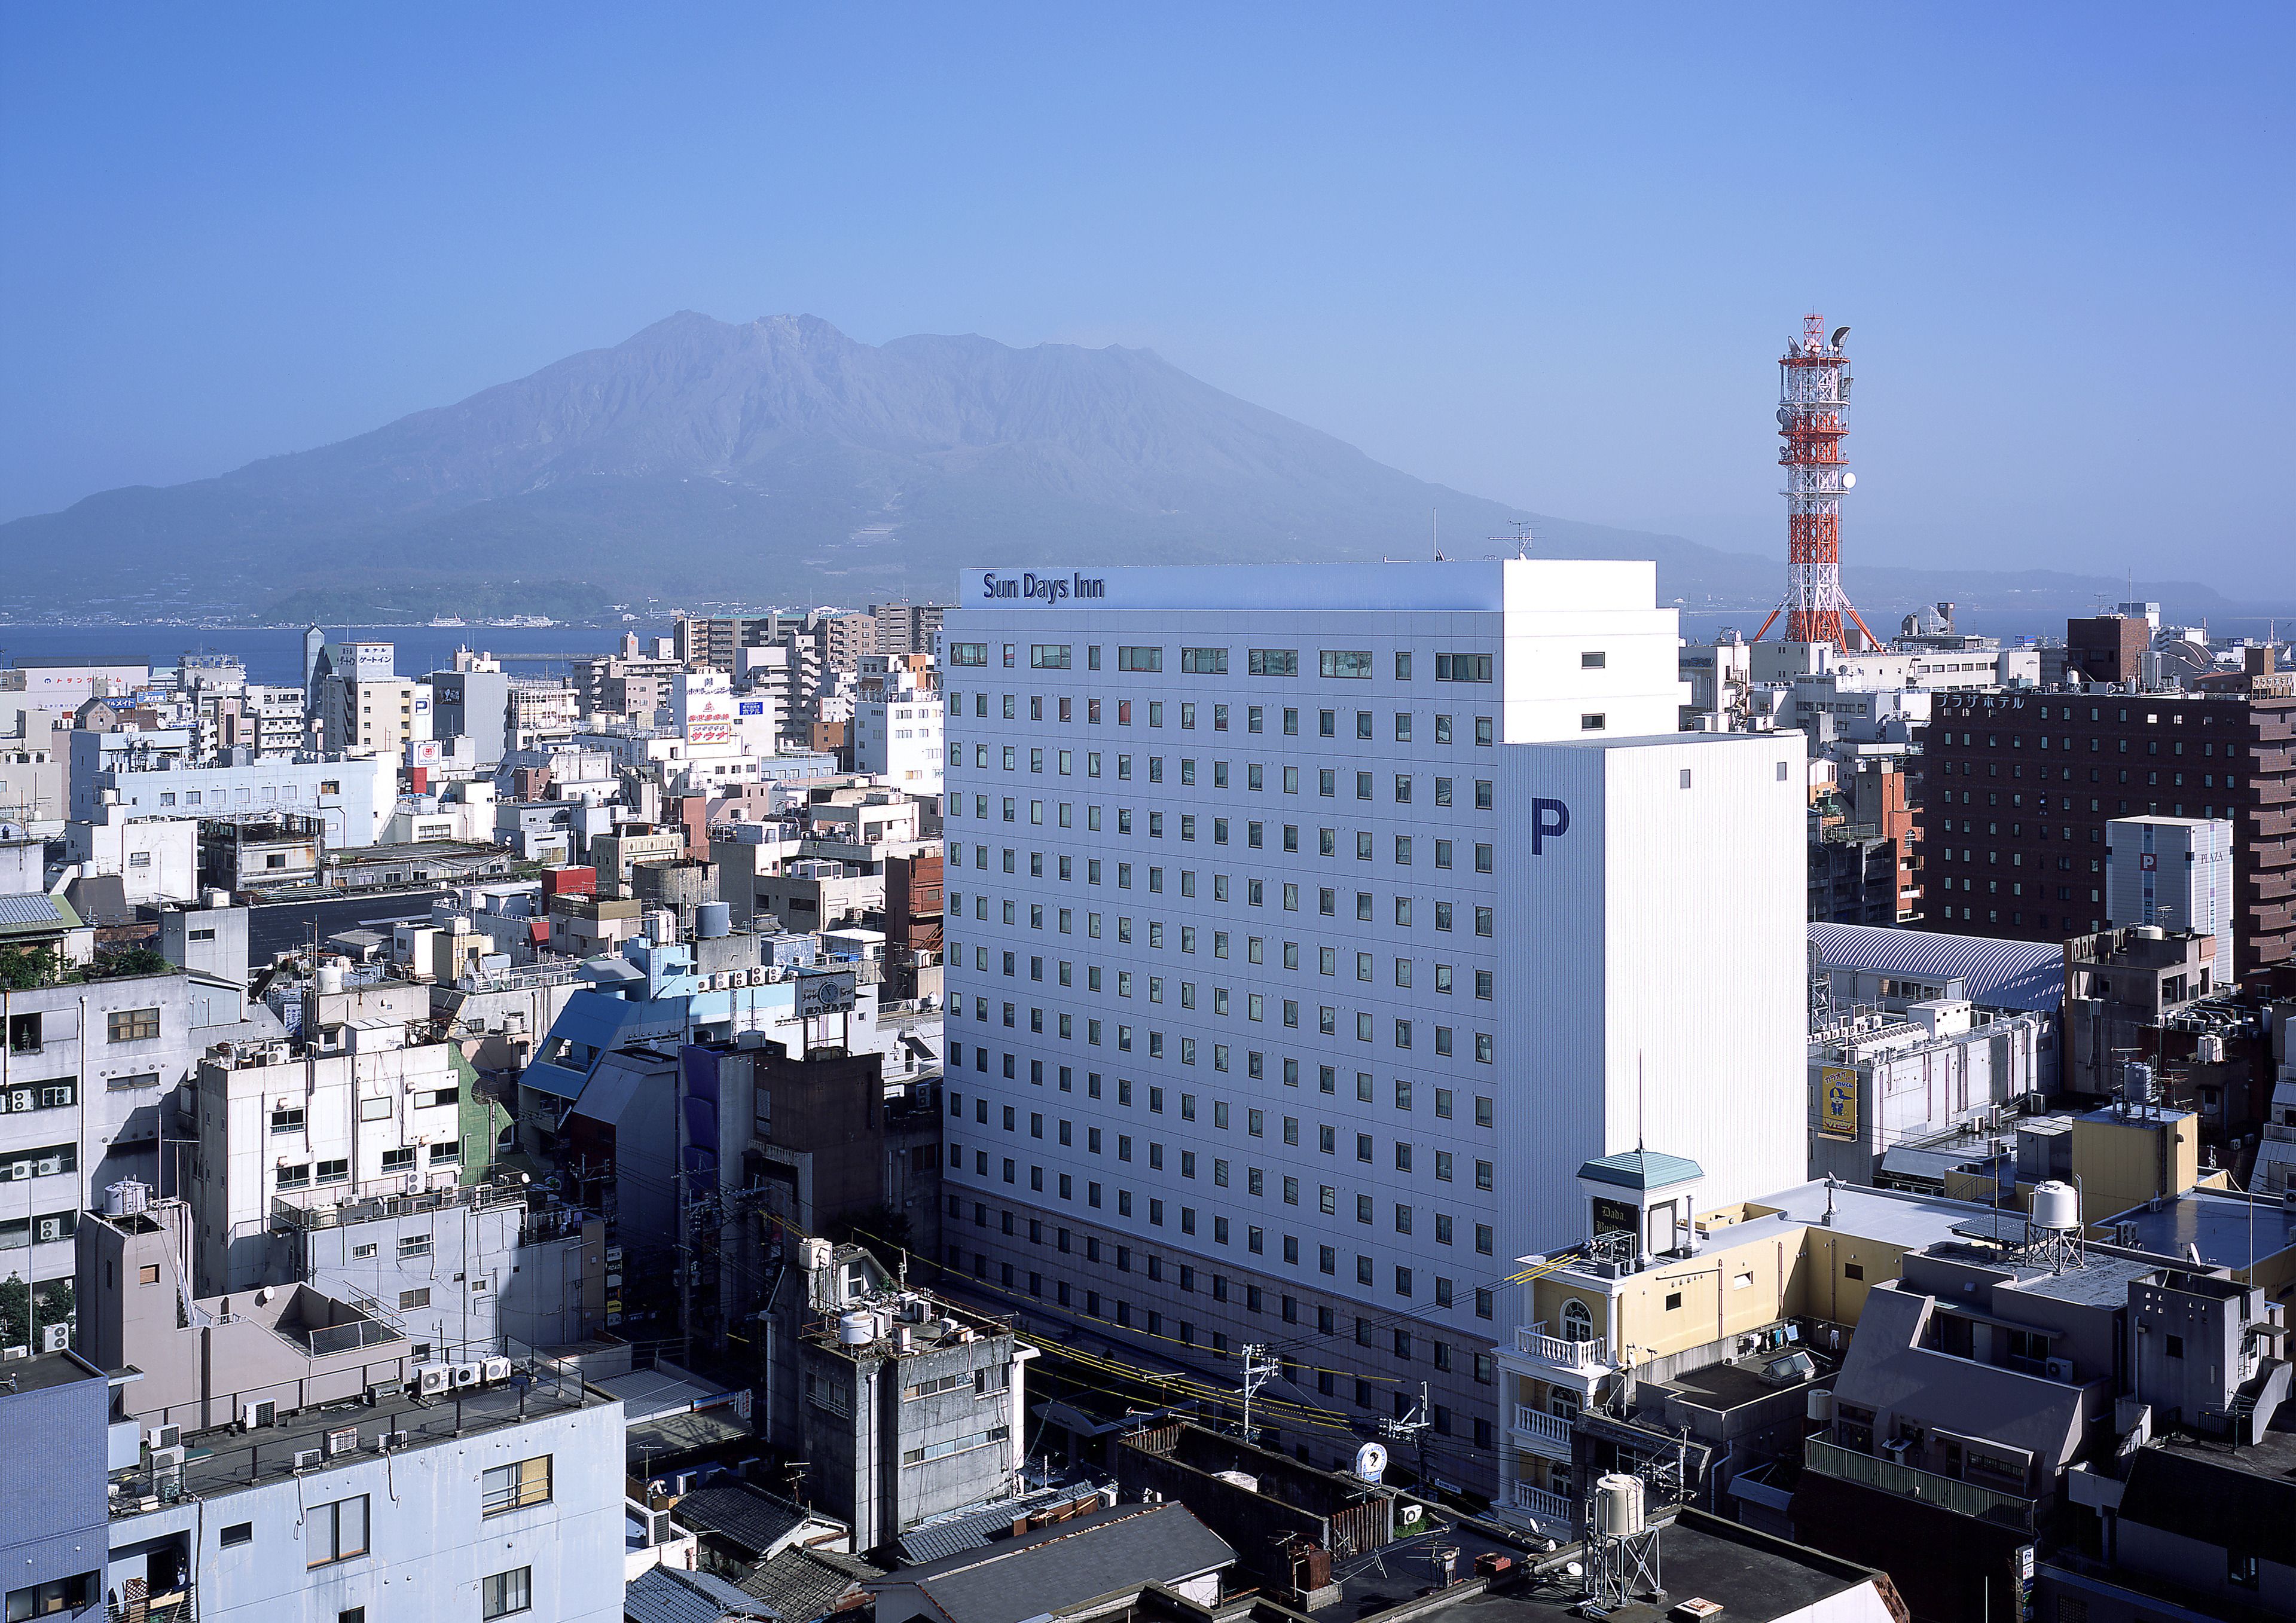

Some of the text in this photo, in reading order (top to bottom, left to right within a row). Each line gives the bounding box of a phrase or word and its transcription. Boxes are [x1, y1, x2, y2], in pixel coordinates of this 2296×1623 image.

[984, 572, 1104, 604] Sun Days Inn
[2254, 677, 2292, 689] プラザホテル
[416, 701, 428, 713] P
[1936, 693, 2025, 709] プラザホテル
[691, 731, 728, 741] サウナ
[1531, 797, 1570, 855] P
[2143, 855, 2154, 869] P
[2201, 851, 2224, 864] PLAZA
[1824, 1071, 1846, 1083] カラオケ
